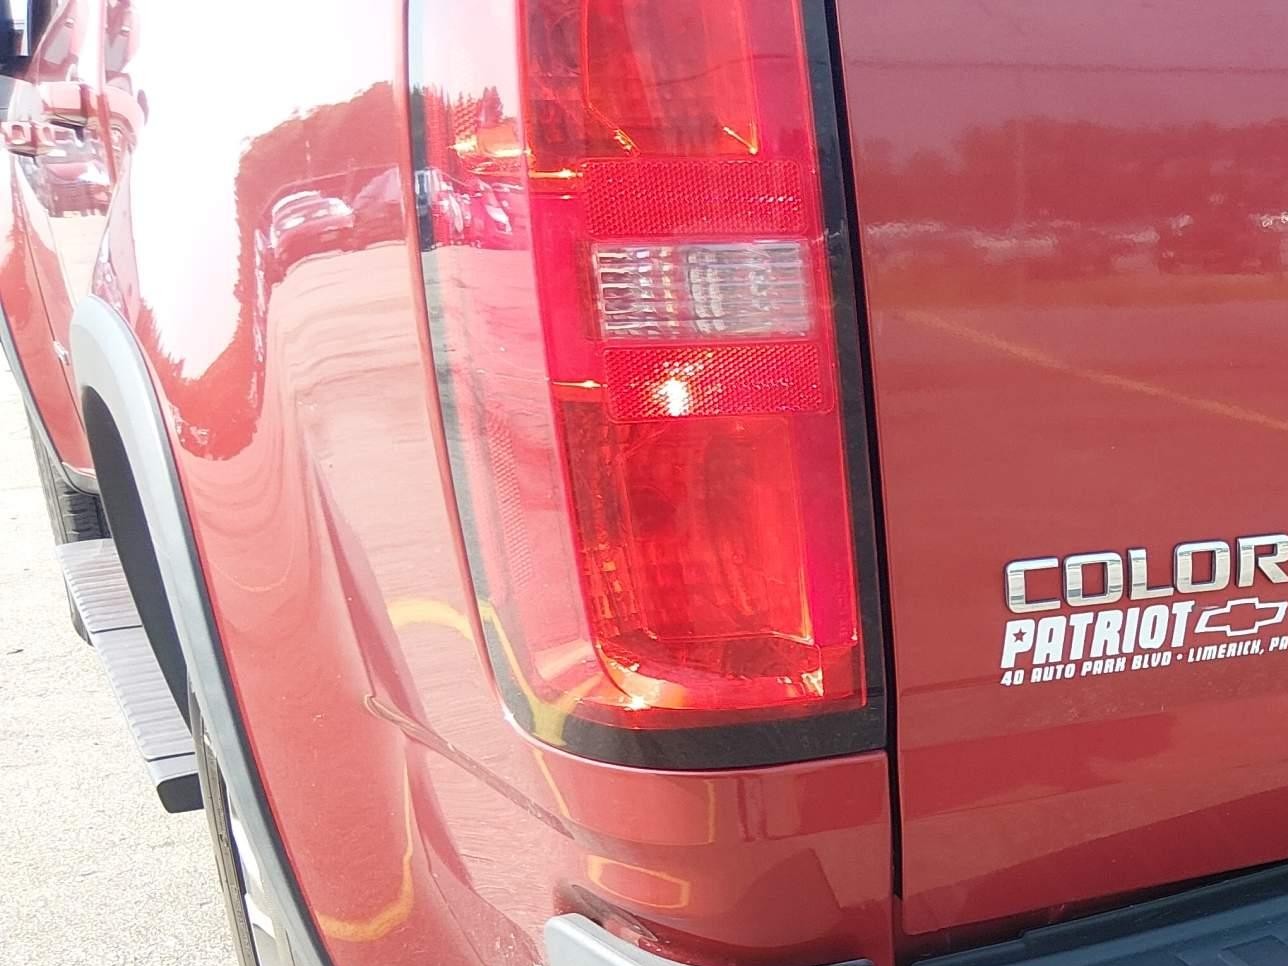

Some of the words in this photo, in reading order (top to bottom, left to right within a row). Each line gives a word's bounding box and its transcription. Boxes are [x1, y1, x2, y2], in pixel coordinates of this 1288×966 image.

[1001, 600, 1196, 669] PATRIOT
[1001, 669, 1025, 686] 40
[1031, 663, 1076, 684] AUTO
[1081, 657, 1127, 677] PARK
[1131, 651, 1171, 671] BLVD
[1188, 639, 1265, 662] LIMERICK,
